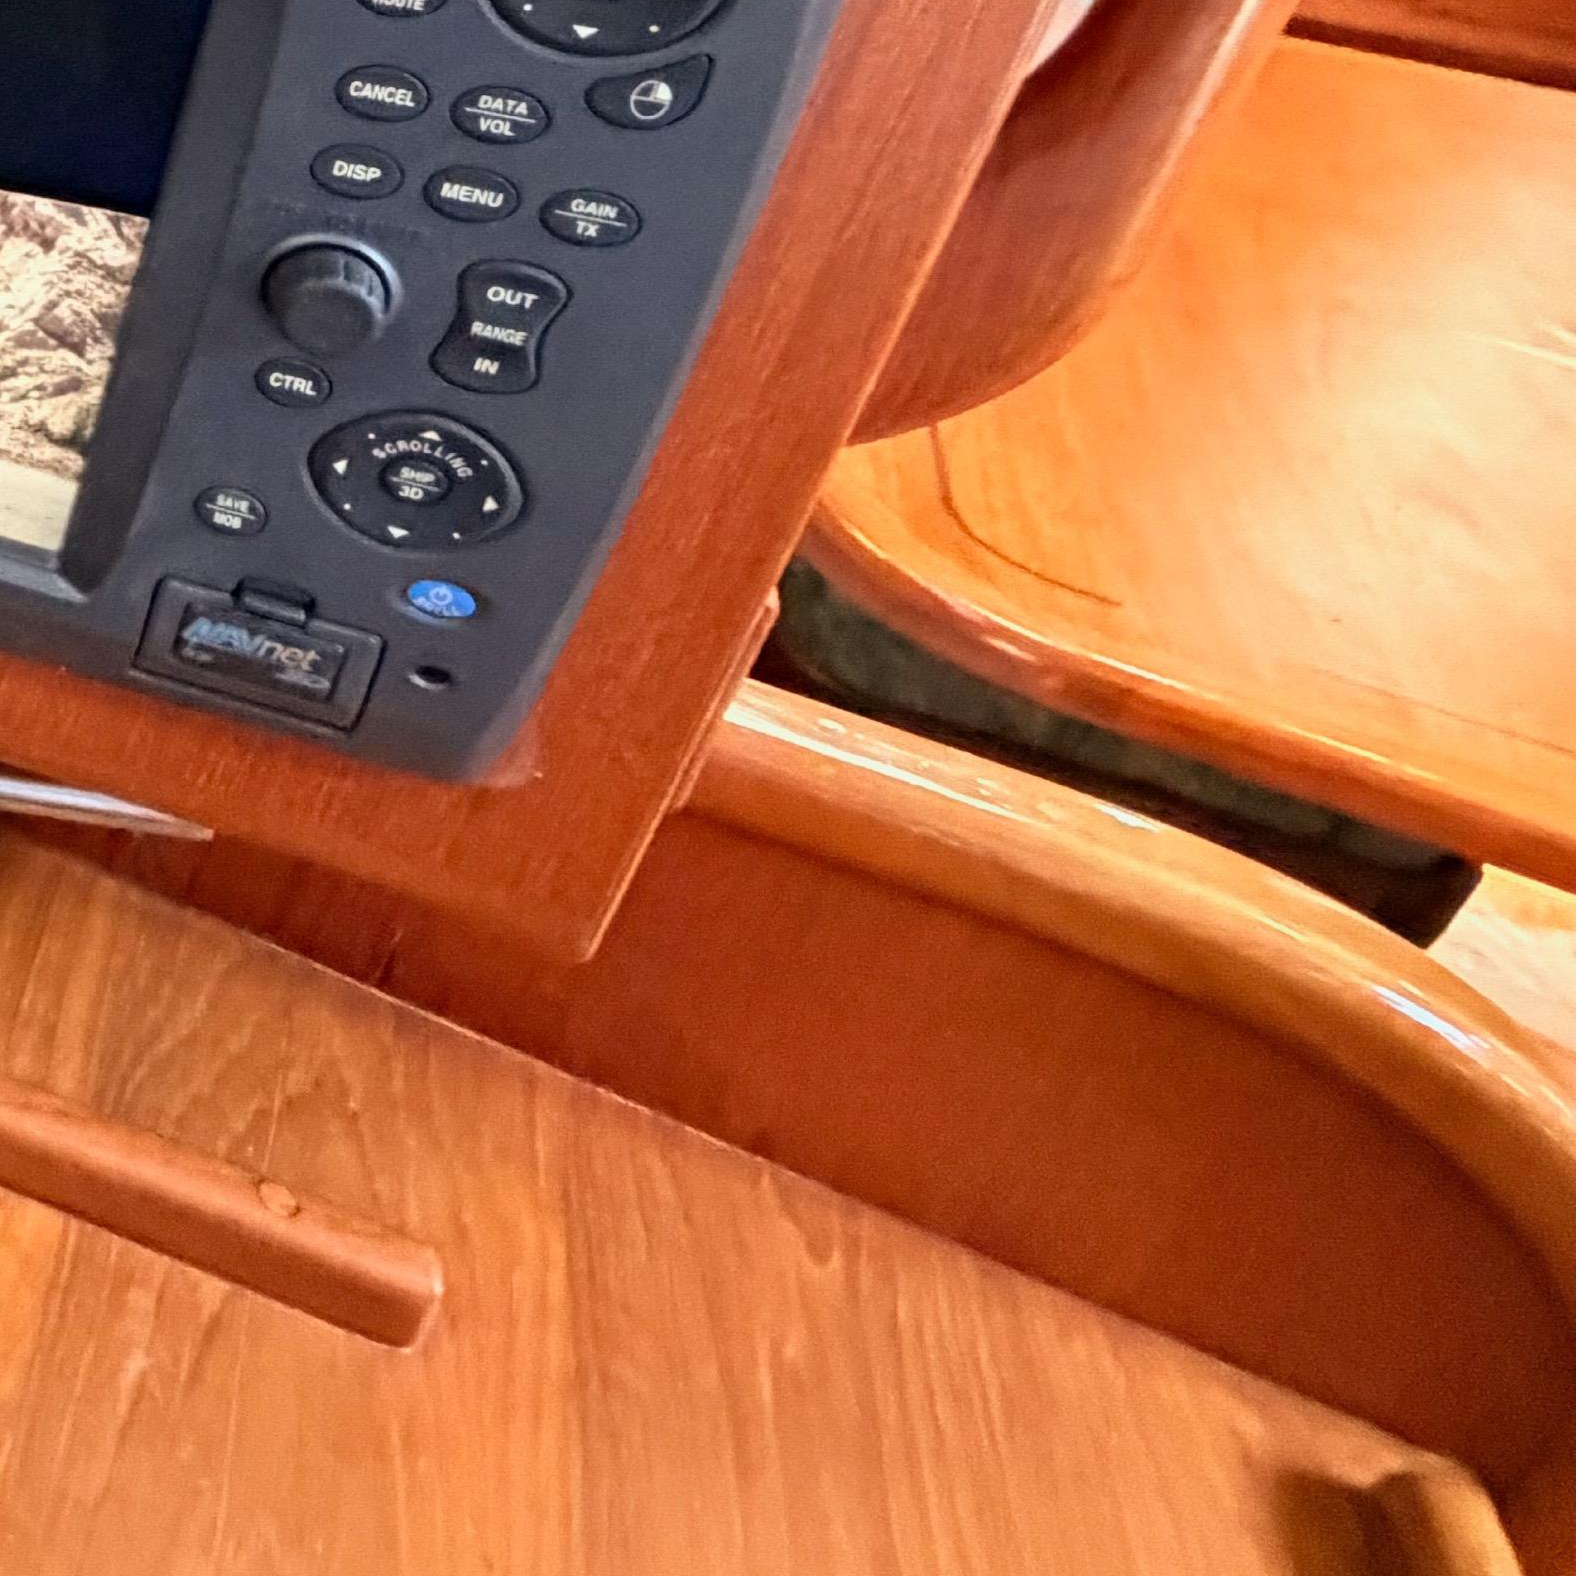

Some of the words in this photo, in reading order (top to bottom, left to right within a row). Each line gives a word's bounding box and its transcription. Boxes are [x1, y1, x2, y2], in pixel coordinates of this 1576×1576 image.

[349, 80, 415, 107] CANCEL
[478, 94, 528, 116] DATA
[479, 118, 515, 136] VOL
[332, 160, 381, 182] DISP
[440, 182, 504, 207] MENU
[570, 198, 618, 219] GAIN
[576, 221, 599, 237] TX
[487, 286, 539, 309] OUT
[471, 321, 528, 346] RANGE
[474, 358, 500, 375] IN
[269, 372, 317, 396] CTRL
[372, 438, 474, 480] SCROLLING
[400, 466, 436, 483] SHIP
[216, 494, 250, 512] SAVE
[399, 485, 424, 501] 3D
[213, 513, 243, 530] MOB
